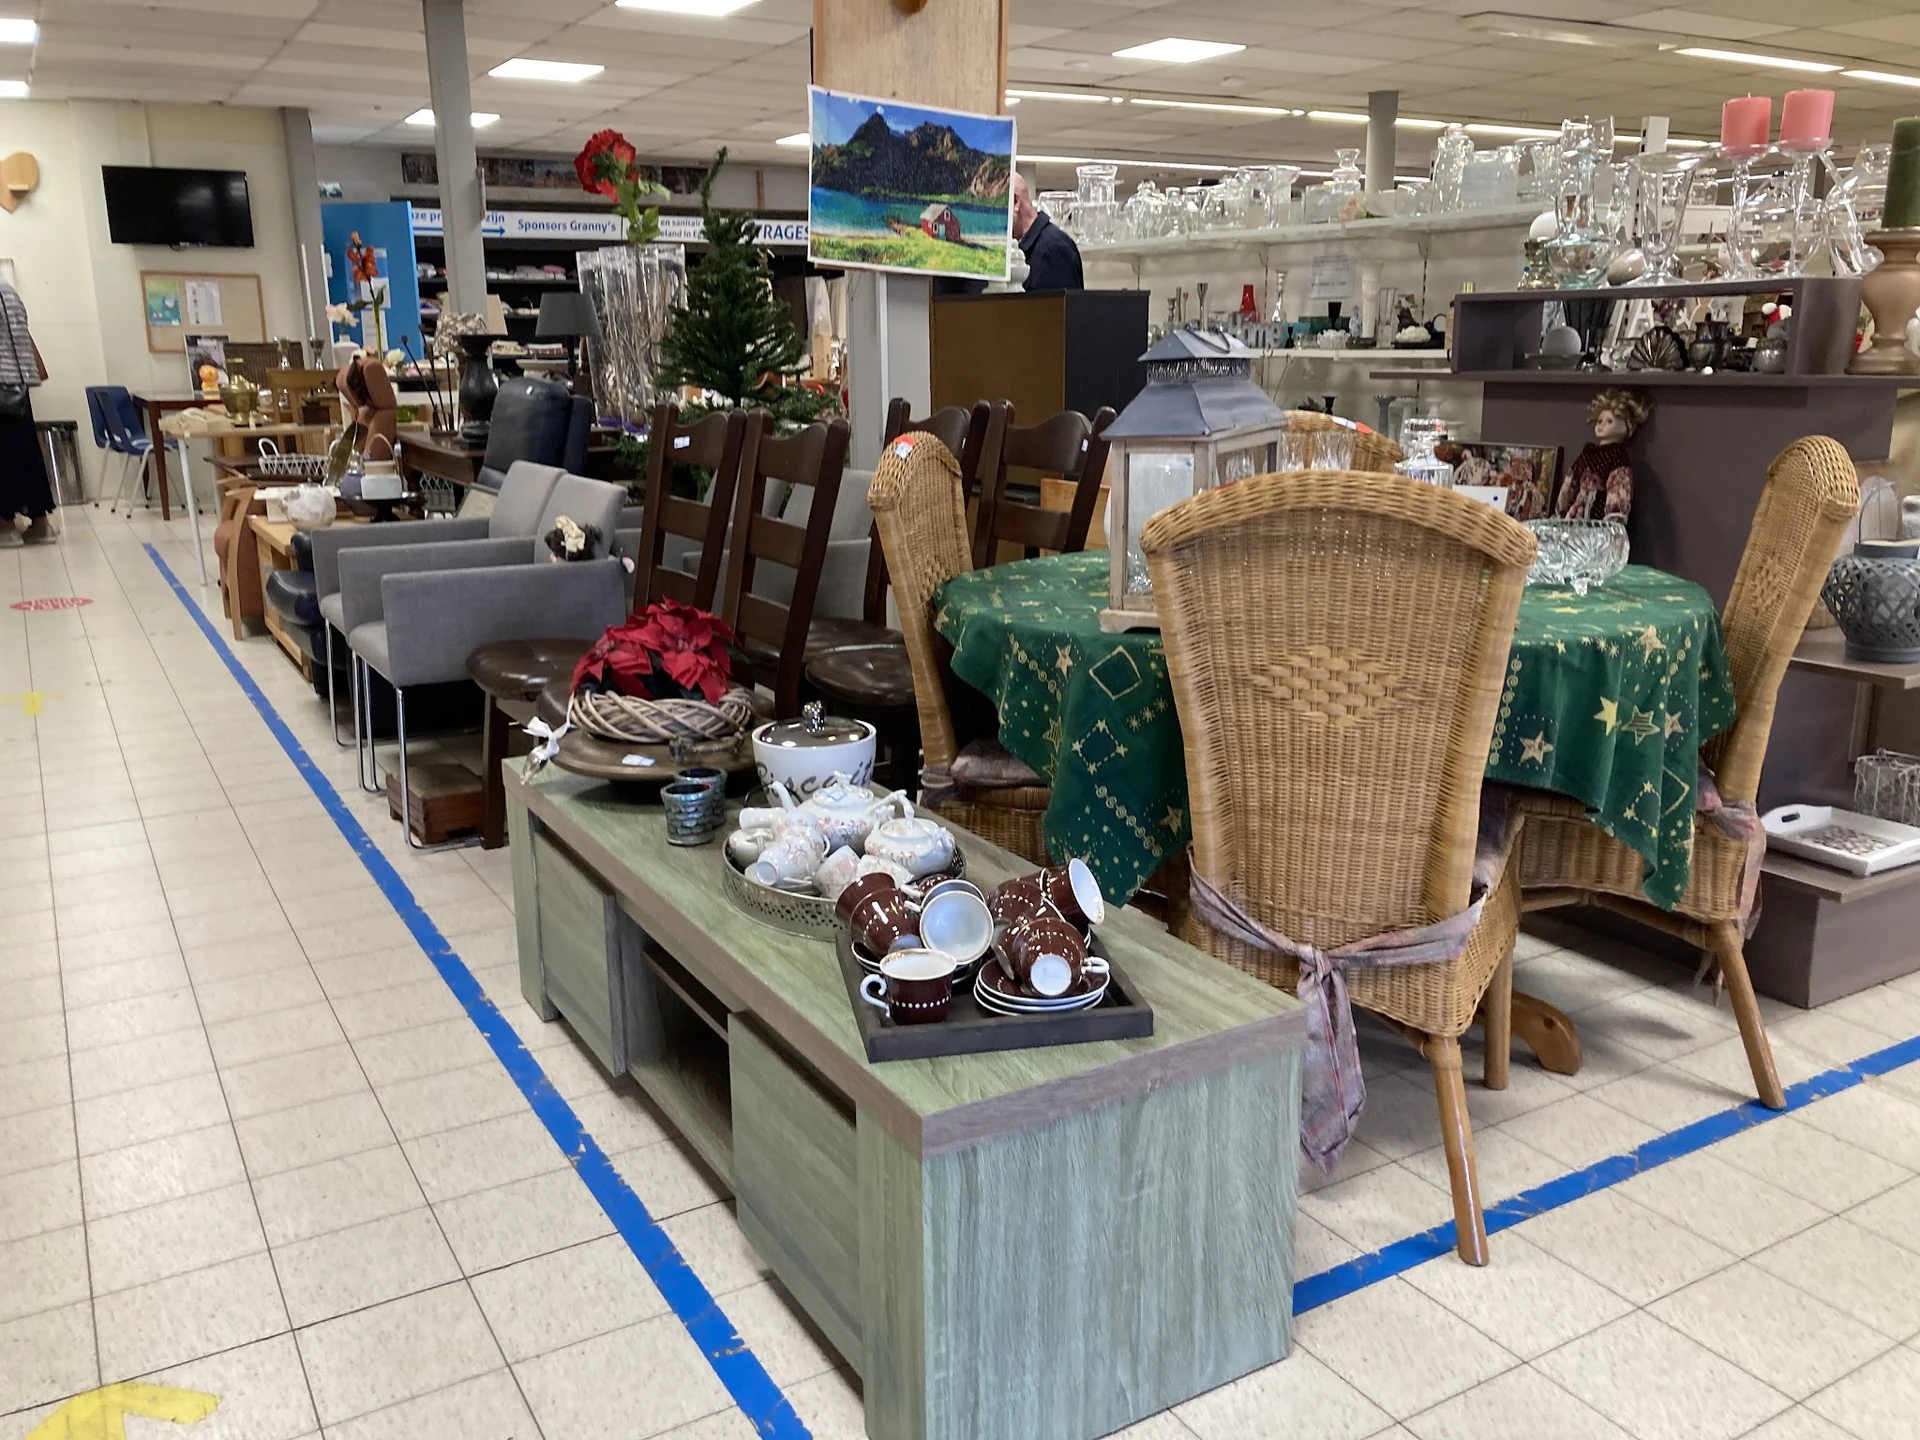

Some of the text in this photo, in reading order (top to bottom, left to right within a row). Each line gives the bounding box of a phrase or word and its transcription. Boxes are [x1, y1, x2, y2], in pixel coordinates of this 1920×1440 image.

[486, 211, 505, 224] zijn
[672, 217, 701, 226] sanitair
[517, 219, 616, 234] Sponsors Granny's
[684, 229, 691, 237] in
